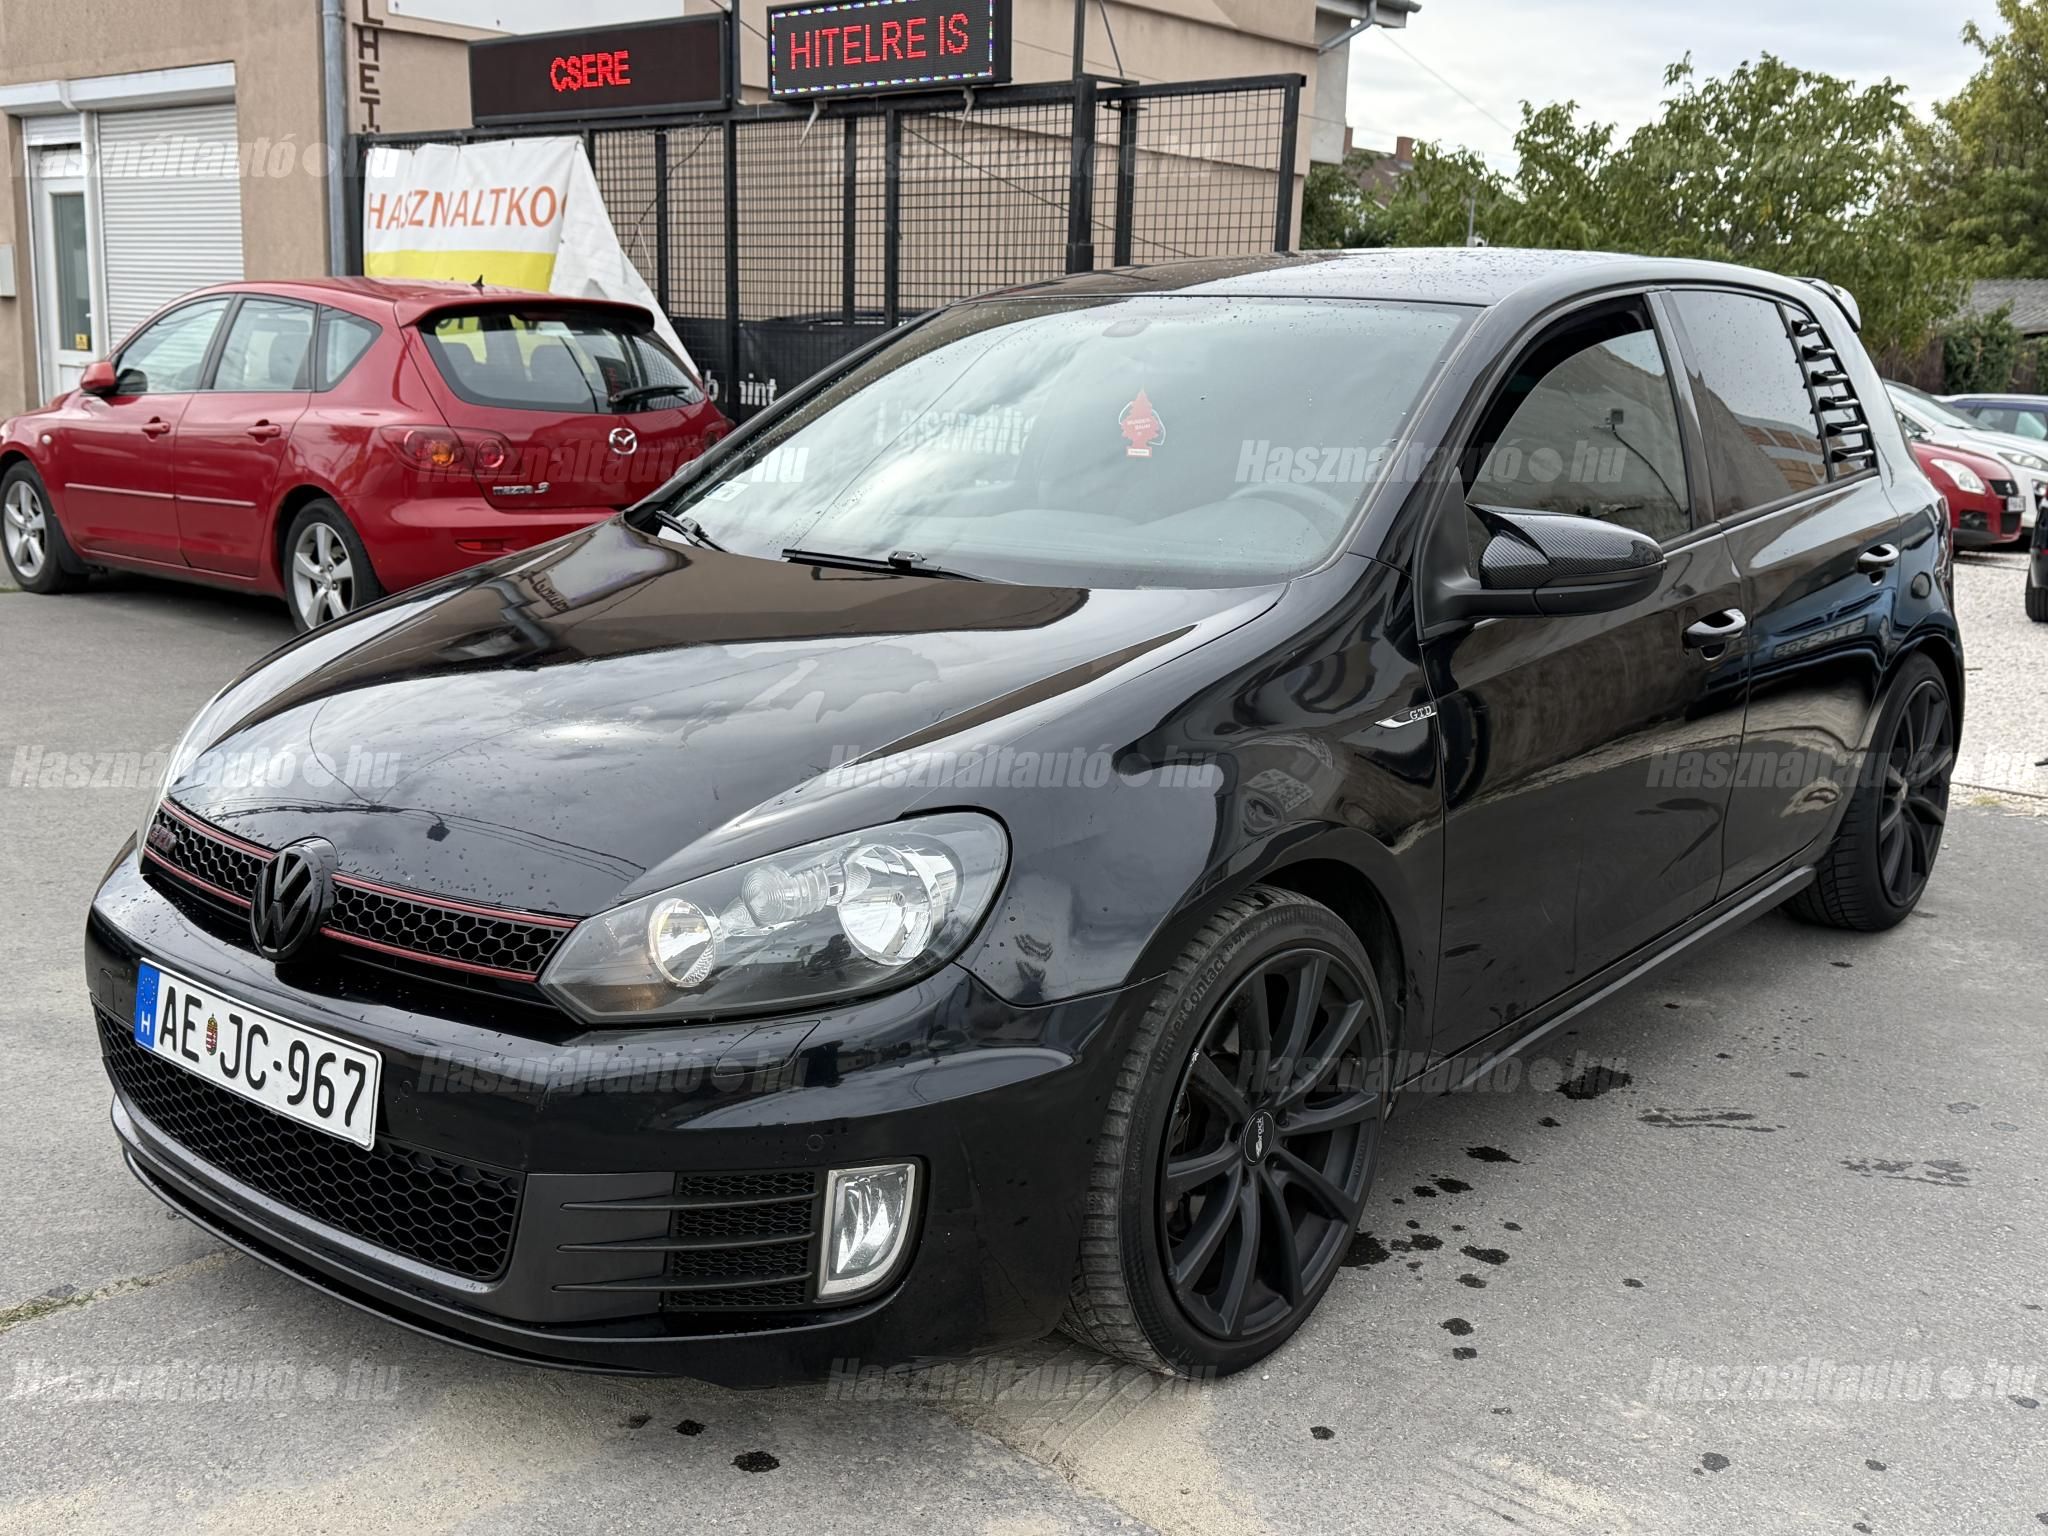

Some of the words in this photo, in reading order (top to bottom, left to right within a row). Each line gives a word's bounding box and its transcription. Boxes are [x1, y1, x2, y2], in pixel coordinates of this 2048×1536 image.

[790, 17, 927, 70] HITELRE
[939, 13, 969, 56] IS
[358, 0, 384, 133] LHET
[550, 50, 631, 92] CSERE
[1409, 705, 1432, 720] GTD
[140, 1013, 150, 1036] H
[160, 985, 203, 1063] AE
